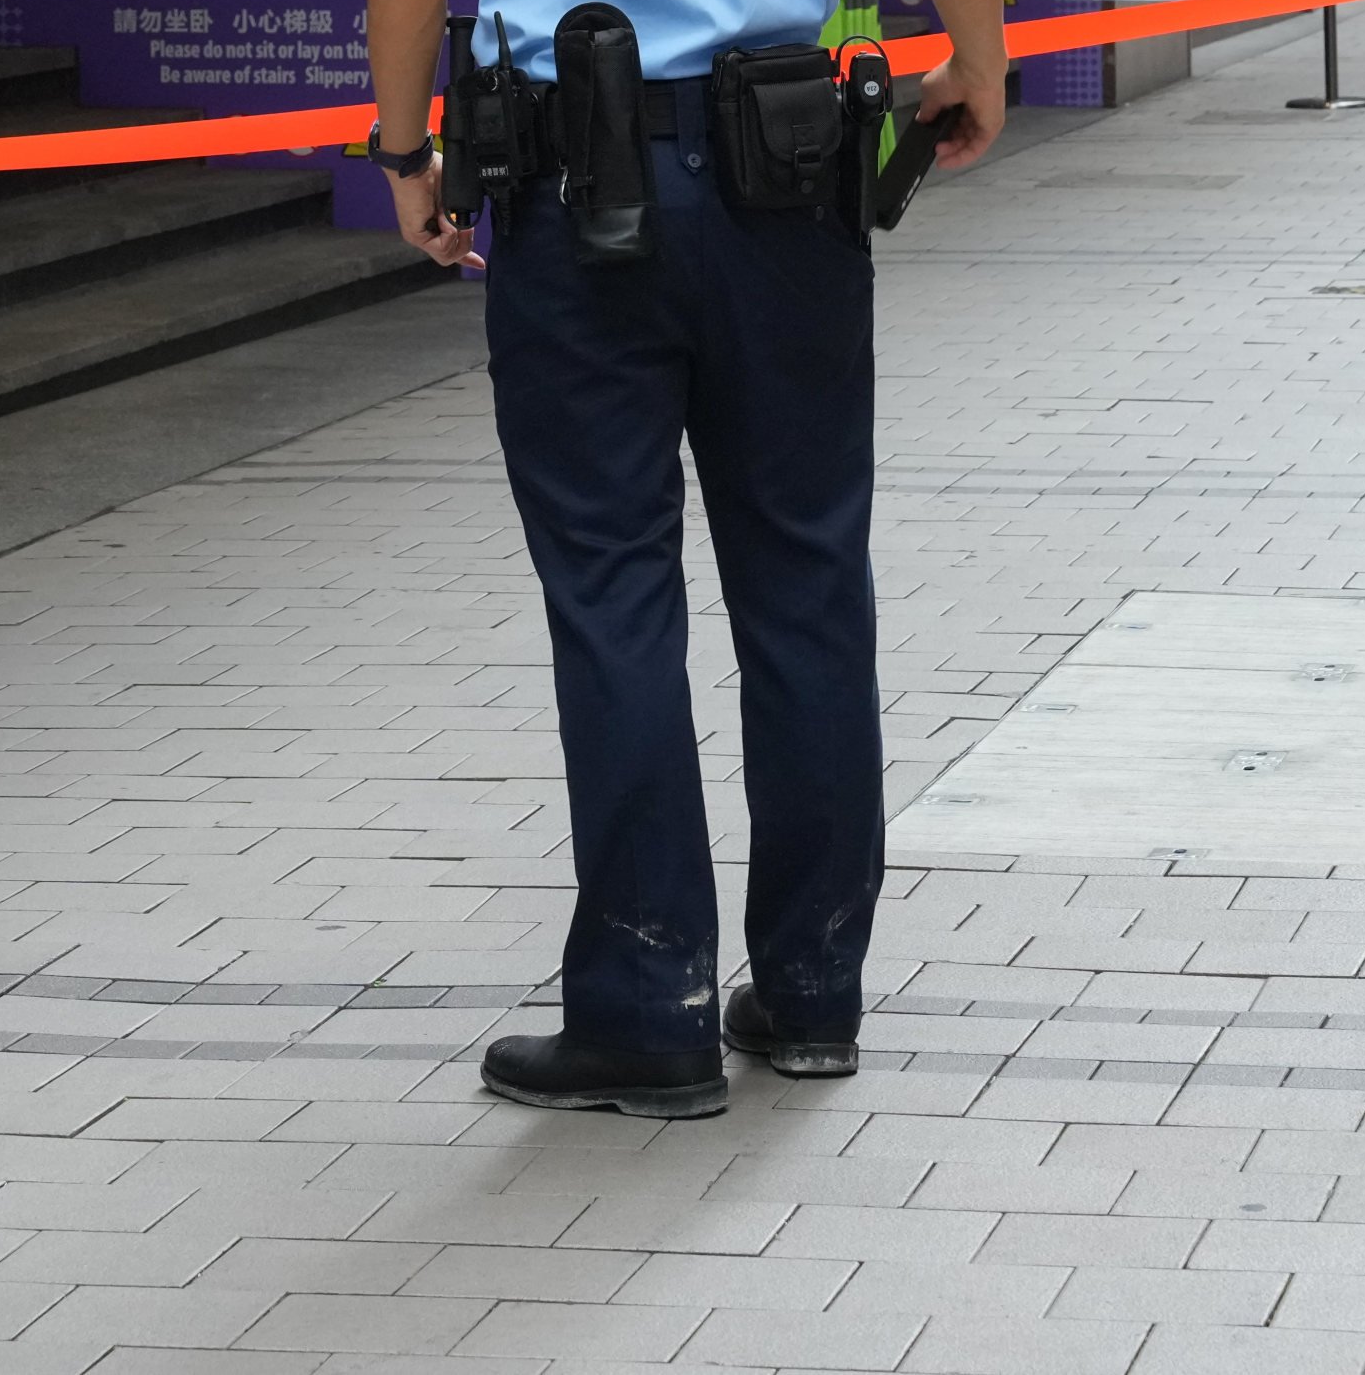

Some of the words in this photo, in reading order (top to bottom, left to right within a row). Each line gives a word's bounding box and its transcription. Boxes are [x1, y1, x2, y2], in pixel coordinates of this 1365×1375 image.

[232, 8, 333, 35] 小心梯級
[149, 39, 201, 60] Please
[204, 39, 223, 60] do
[225, 42, 253, 60] not
[255, 40, 275, 60] sit
[278, 45, 295, 60] or
[297, 39, 322, 65] lay
[325, 45, 344, 60] on
[346, 39, 368, 60] the
[160, 65, 181, 85] Be
[183, 70, 231, 85] aware
[234, 65, 252, 85] of
[254, 66, 296, 85] stairs
[305, 65, 369, 90] Slippery
